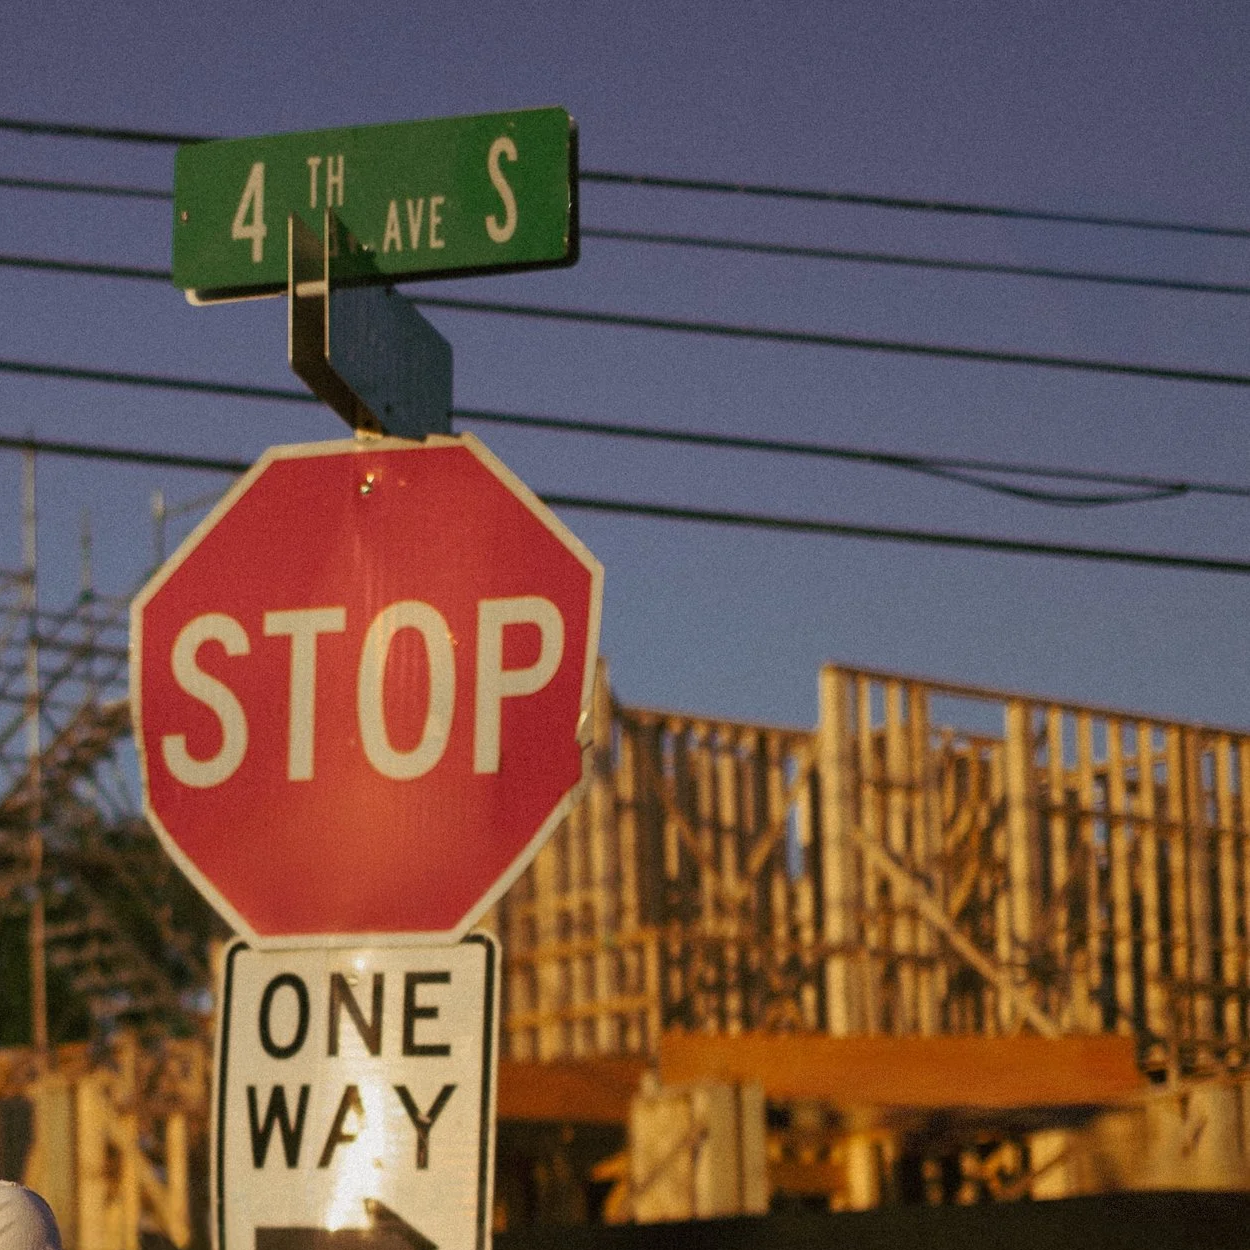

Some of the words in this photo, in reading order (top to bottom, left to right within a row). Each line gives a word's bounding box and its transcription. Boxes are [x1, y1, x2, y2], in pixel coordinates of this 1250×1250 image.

[231, 162, 267, 263] 4
[307, 154, 345, 209] TH
[382, 196, 446, 254] AVE
[484, 136, 519, 244] S
[161, 595, 566, 789] STOP
[257, 971, 452, 1060] ONE
[245, 1084, 458, 1170] WAY
